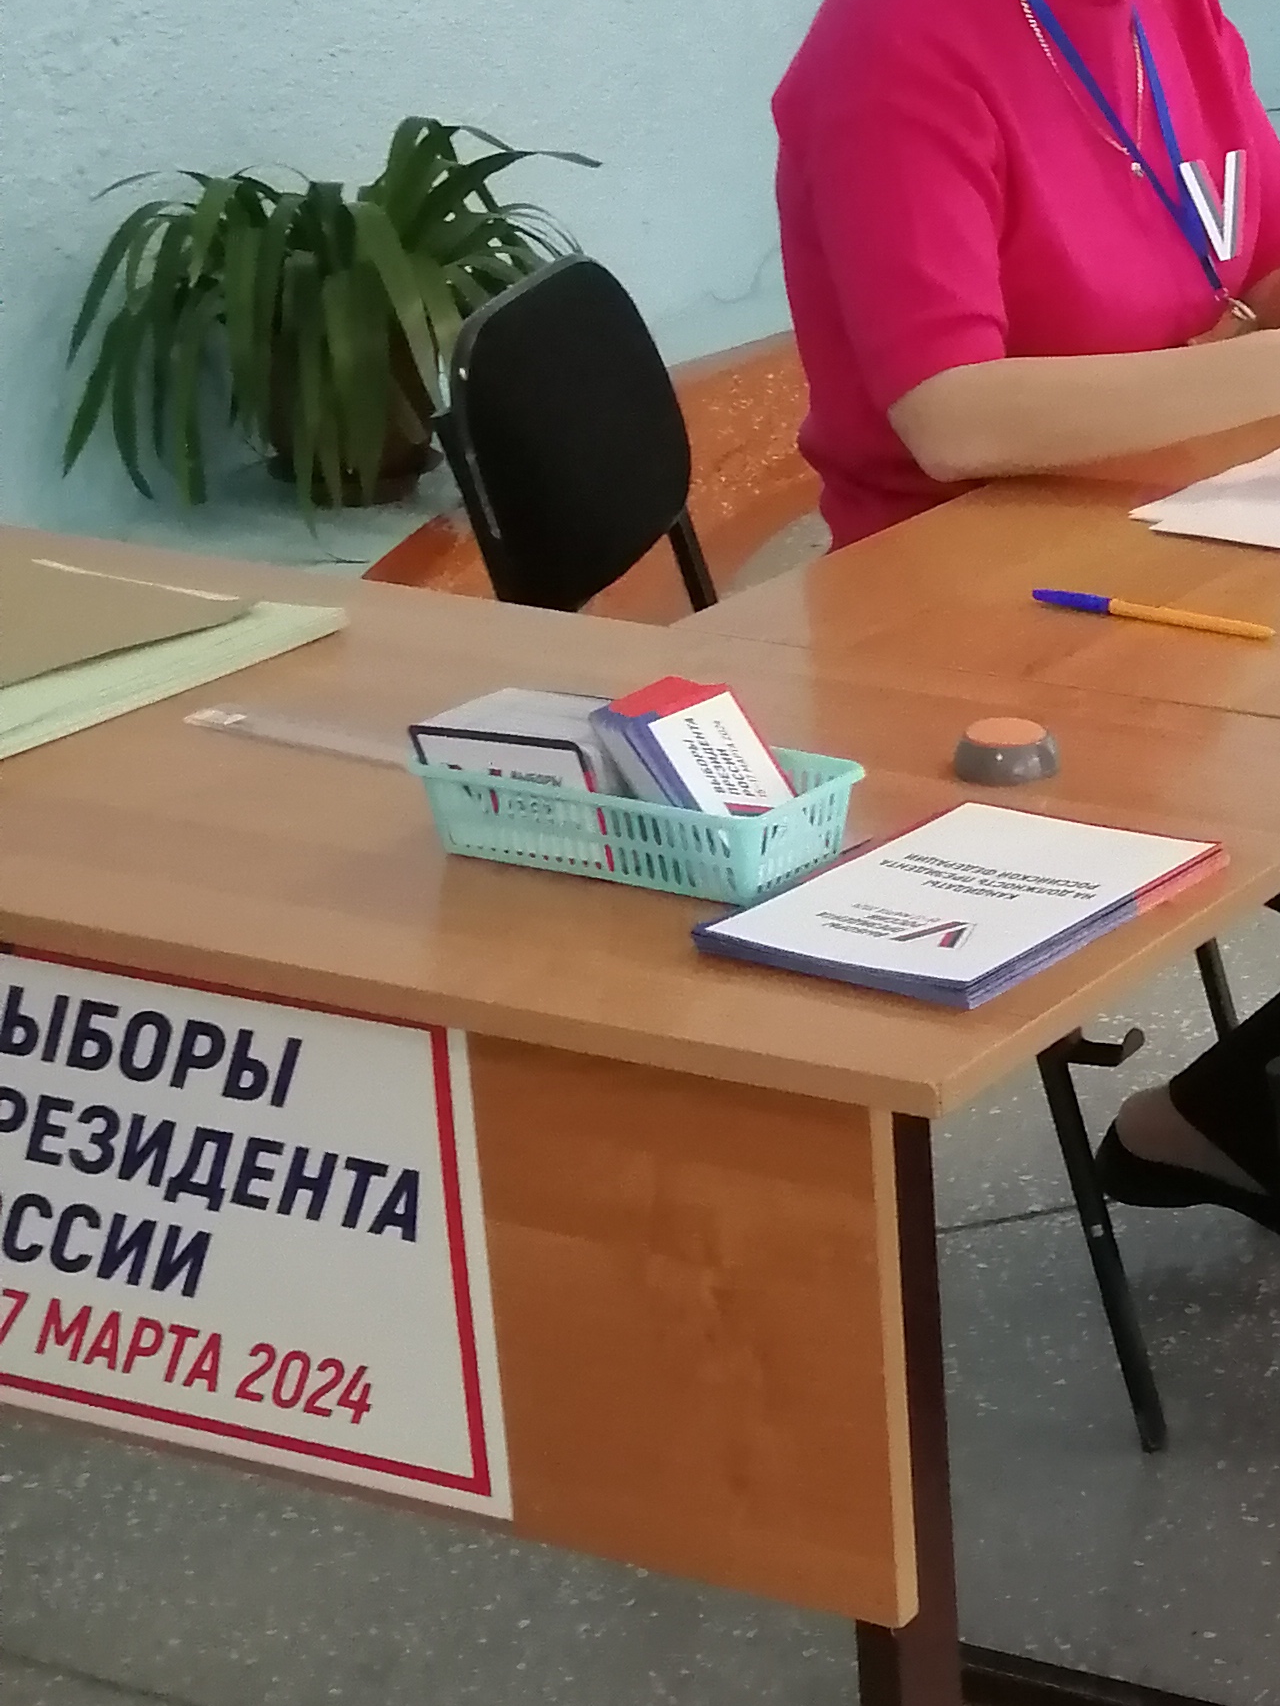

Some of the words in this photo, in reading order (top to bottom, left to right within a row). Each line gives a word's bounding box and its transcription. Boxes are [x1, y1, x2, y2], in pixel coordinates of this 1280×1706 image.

[683, 739, 726, 794] ВЫБОРЫ
[684, 717, 741, 795] ПРЕЗИДЕНТА
[716, 748, 756, 797] РОССИИ
[879, 859, 977, 883] ПРЕЗИДЕНТА
[904, 853, 997, 875] ФЕДЕРАЦИИ
[921, 879, 1020, 900] КАНДИДАТЫ
[978, 878, 1074, 897] ДОЛЖНОСТЬ
[1073, 892, 1097, 900] НА
[0, 1192, 212, 1298] ССИИ
[35, 1297, 221, 1393] МАРТА
[235, 1343, 373, 1425] 2024
